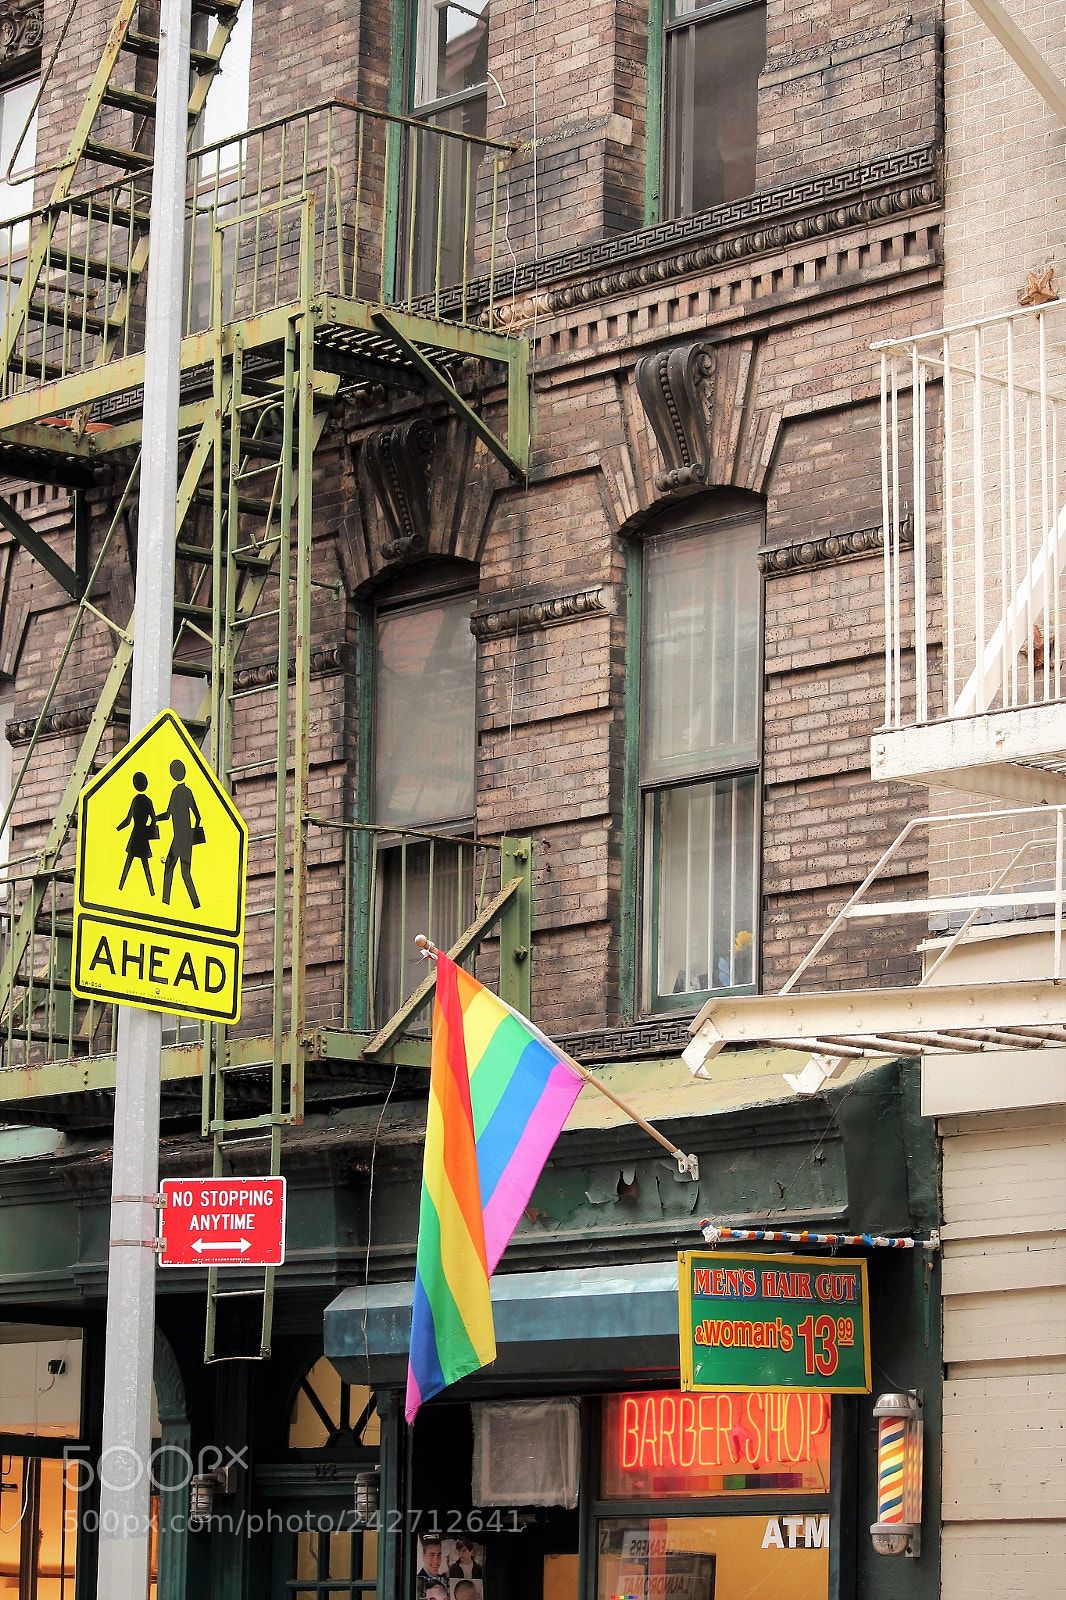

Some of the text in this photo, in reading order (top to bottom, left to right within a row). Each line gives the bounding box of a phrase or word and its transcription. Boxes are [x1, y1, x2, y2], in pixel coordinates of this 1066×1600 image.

[89, 936, 226, 993] AHEAD
[172, 1189, 273, 1207] NO STOPPING
[189, 1213, 255, 1231] ANYTIME
[694, 1268, 857, 1301] MEN'S HAIR CUT
[622, 1392, 827, 1468] BARBER SHOP
[761, 1517, 829, 1549] ATM
